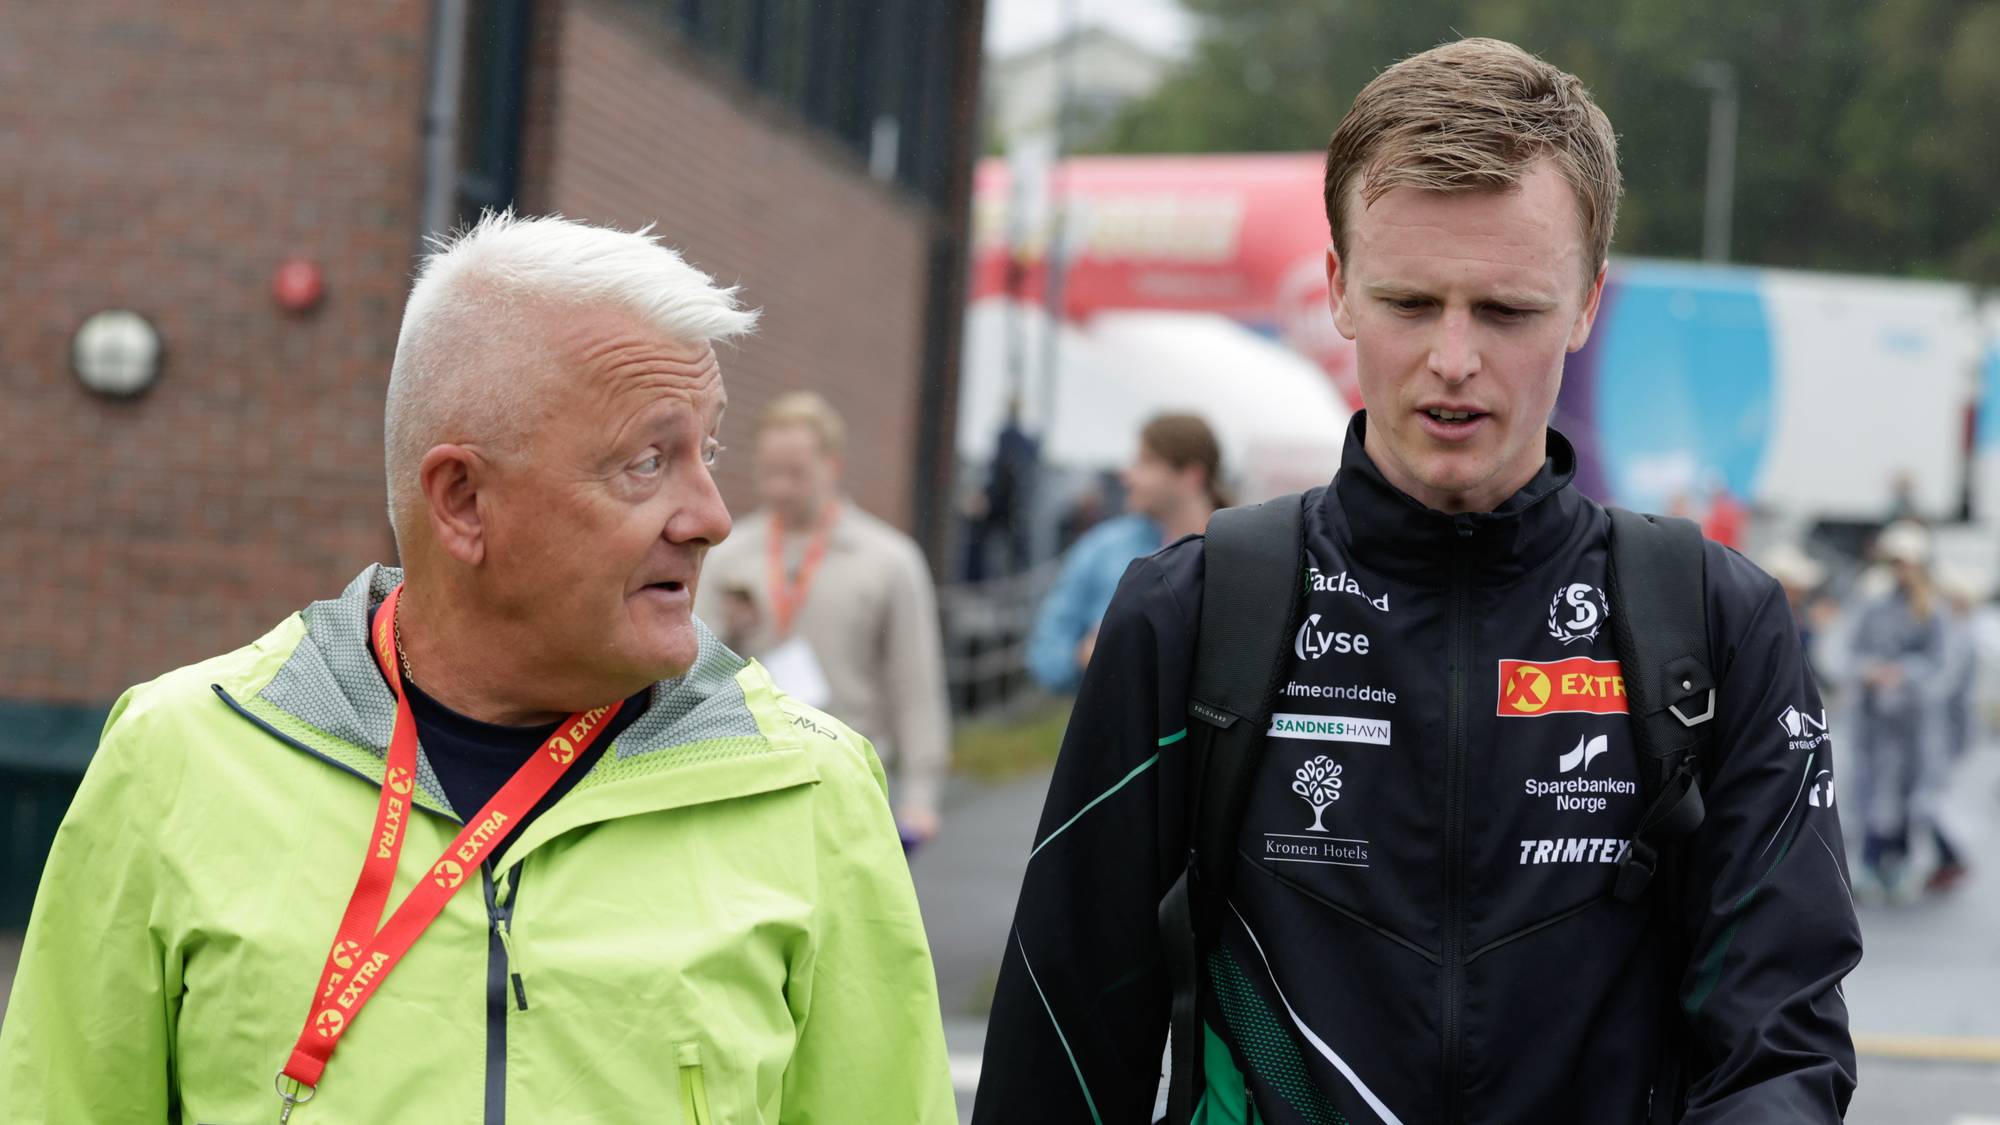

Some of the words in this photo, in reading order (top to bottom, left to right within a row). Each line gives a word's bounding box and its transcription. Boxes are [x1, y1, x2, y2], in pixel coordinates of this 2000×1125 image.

[1305, 626, 1369, 659] Lyse
[1287, 680, 1397, 704] timeanddate
[1562, 673, 1627, 697] EXTR
[1525, 777, 1635, 797] Sparebanken
[1557, 795, 1607, 813] Norge
[376, 797, 403, 860] EXTRA
[456, 810, 508, 864] EXTRA
[1266, 840, 1318, 856] Kronen
[1324, 844, 1368, 860] Hotels
[1520, 838, 1630, 865] TRIMTEX
[337, 951, 390, 1009] EXTRA
